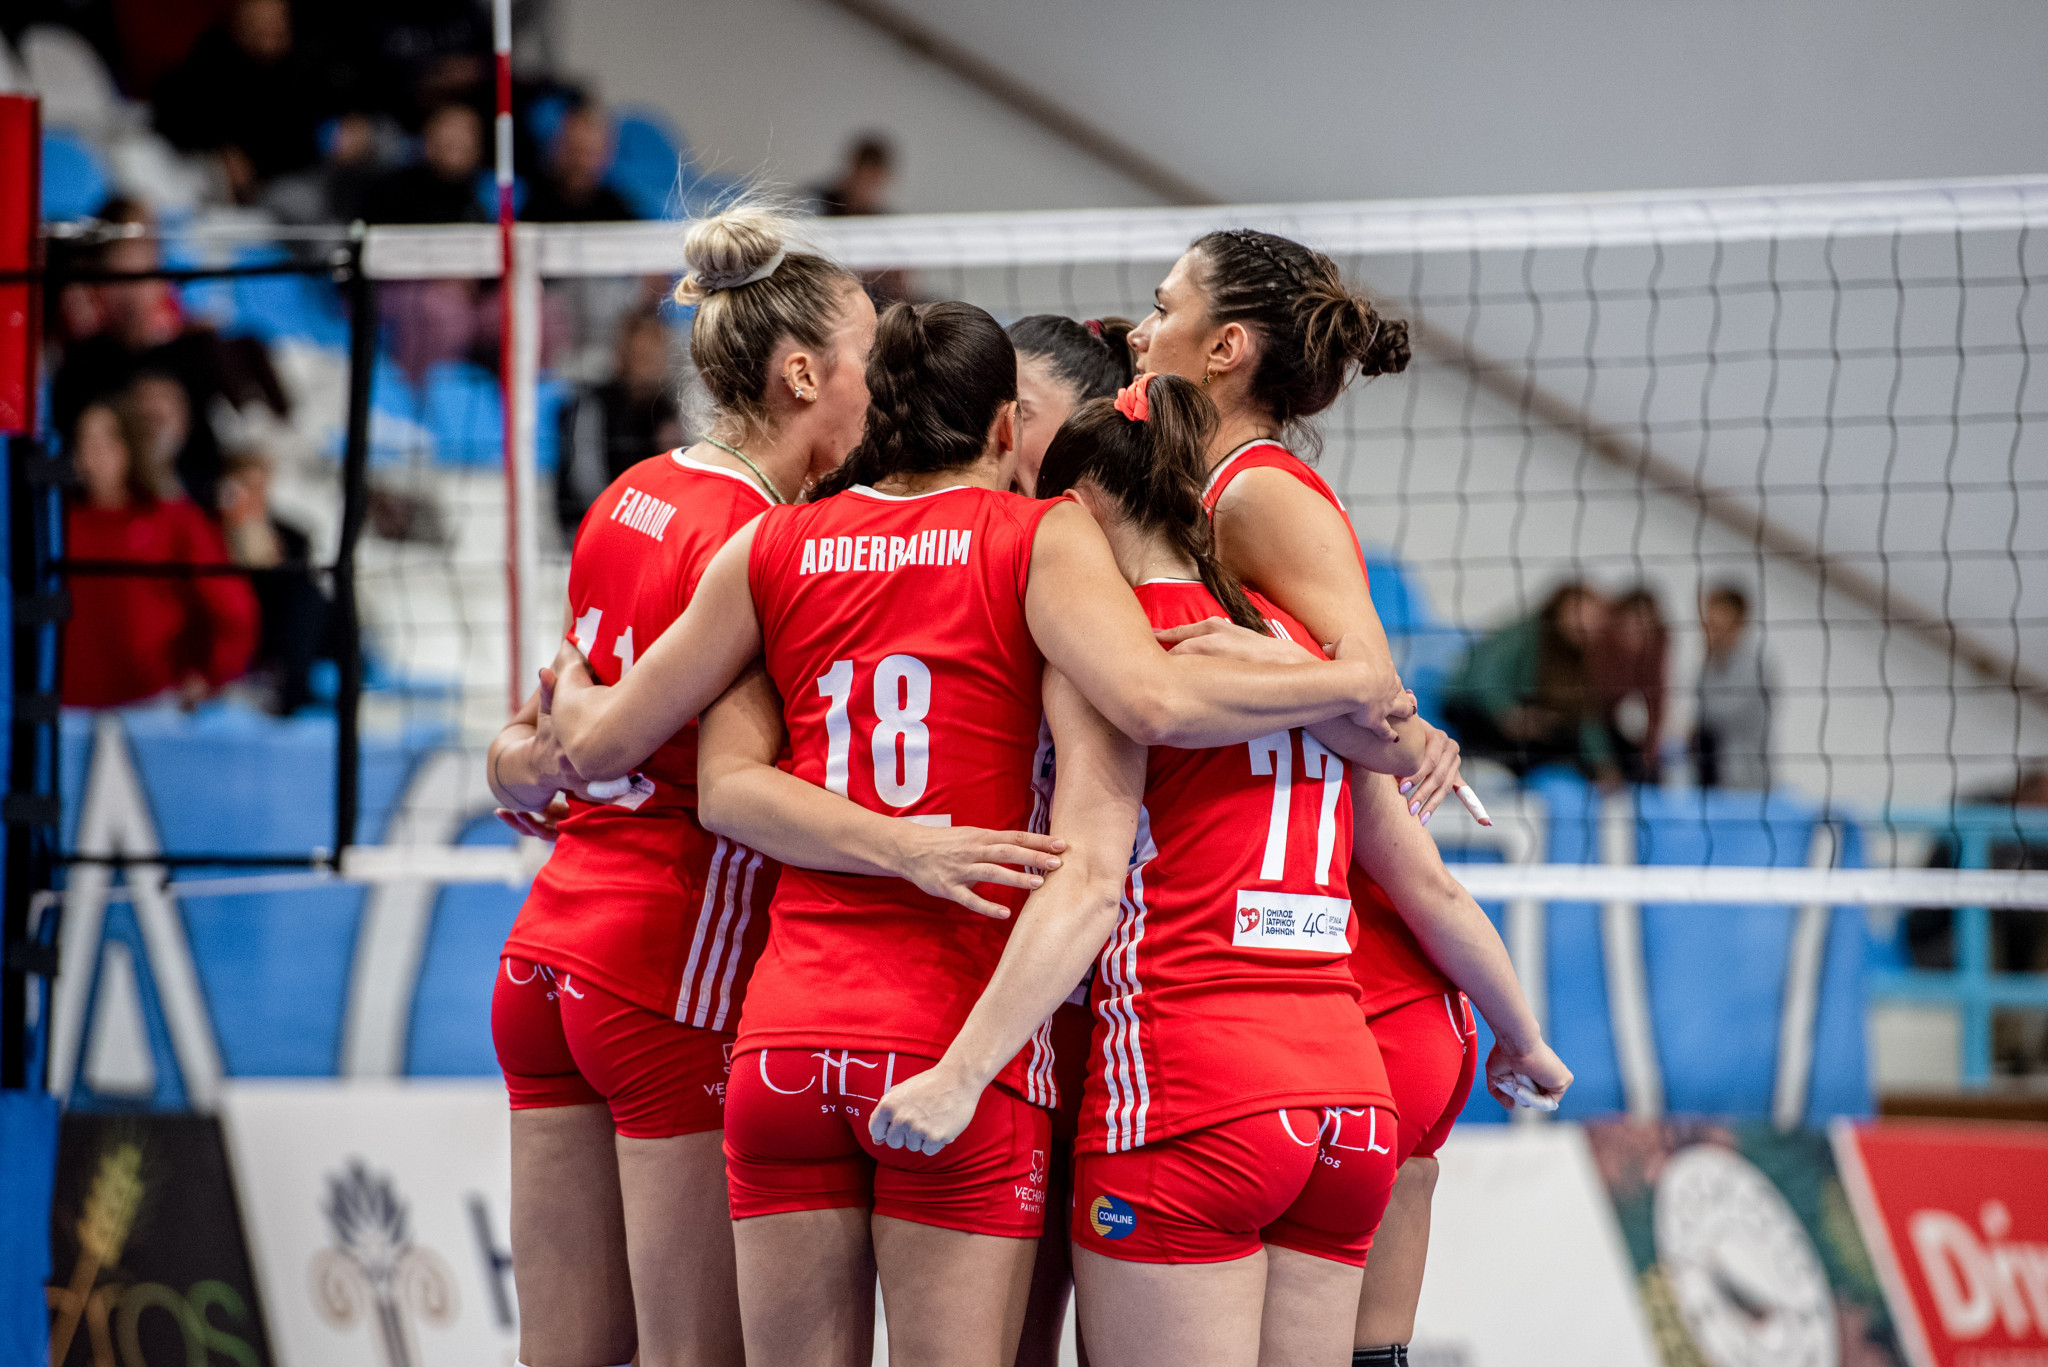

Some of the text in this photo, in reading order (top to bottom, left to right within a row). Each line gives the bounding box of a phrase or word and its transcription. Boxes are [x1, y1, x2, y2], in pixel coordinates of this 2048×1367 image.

[610, 486, 678, 542] FARRIOL
[799, 529, 972, 576] ABDERRAHIM
[816, 654, 932, 808] 18
[1248, 729, 1344, 886] 77
[821, 1104, 861, 1117] SYOS
[1098, 1211, 1133, 1225] COMLINE
